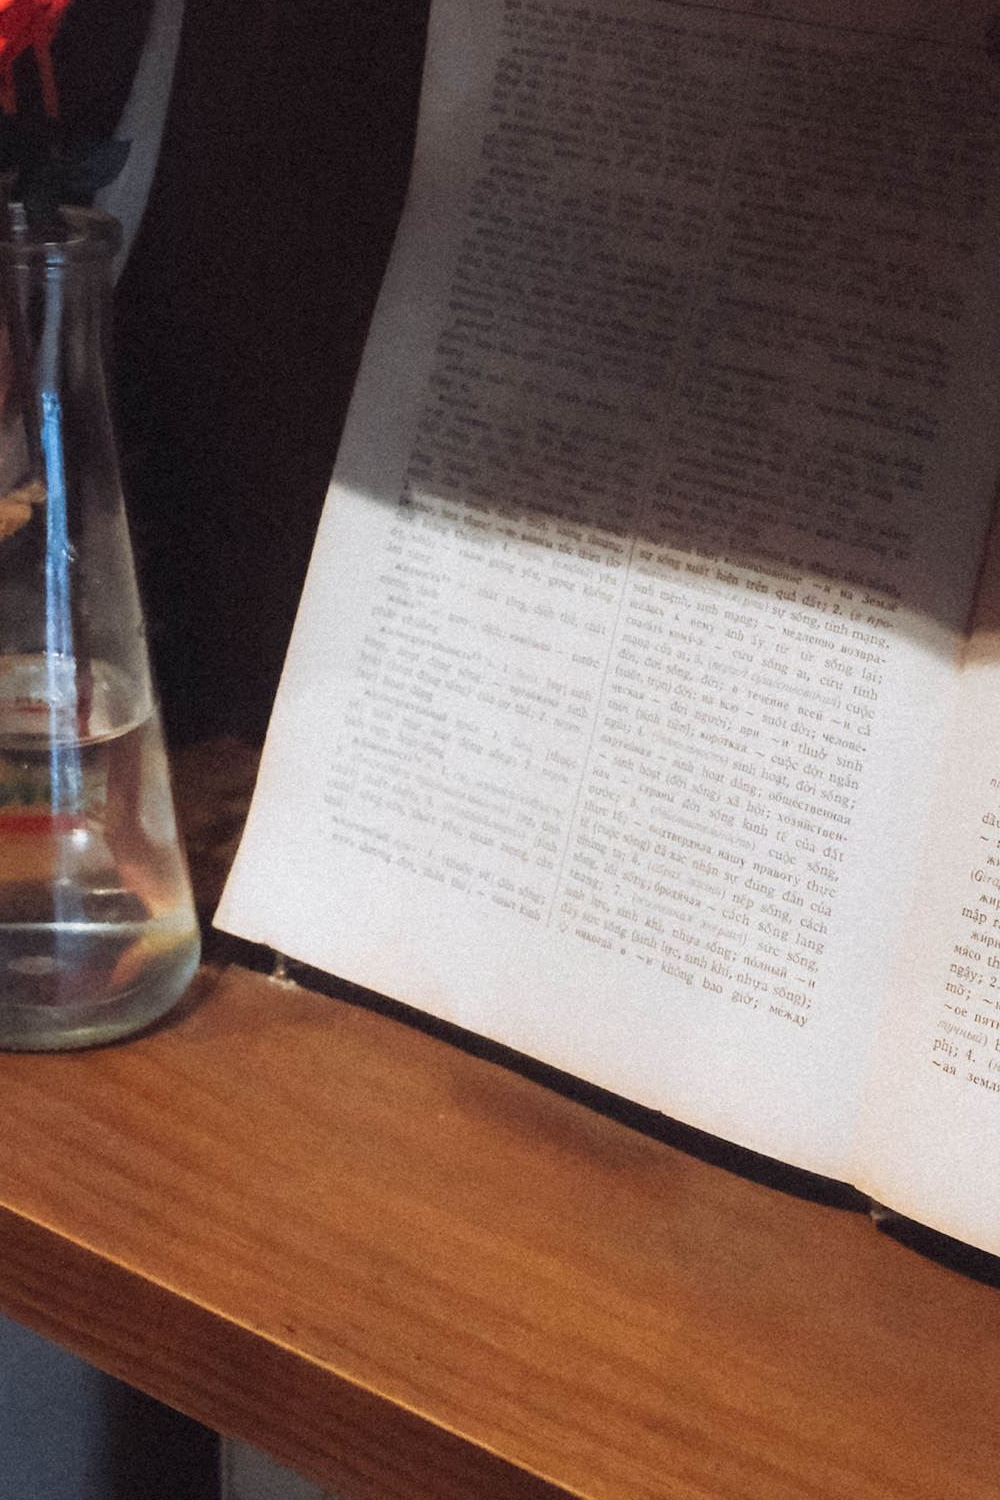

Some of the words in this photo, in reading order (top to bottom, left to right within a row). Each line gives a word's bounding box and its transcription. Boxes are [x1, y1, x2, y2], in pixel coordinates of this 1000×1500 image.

[714, 568, 740, 587] hiện
[745, 578, 769, 594] trên
[832, 603, 844, 615] 2.
[835, 753, 865, 773] sinh
[799, 912, 830, 936] cách
[961, 907, 988, 926] mập
[794, 930, 826, 956] lang
[949, 963, 983, 985] ngậy;
[702, 976, 724, 996] bao
[945, 982, 972, 1001] mỡ;
[965, 1048, 976, 1063] 4.
